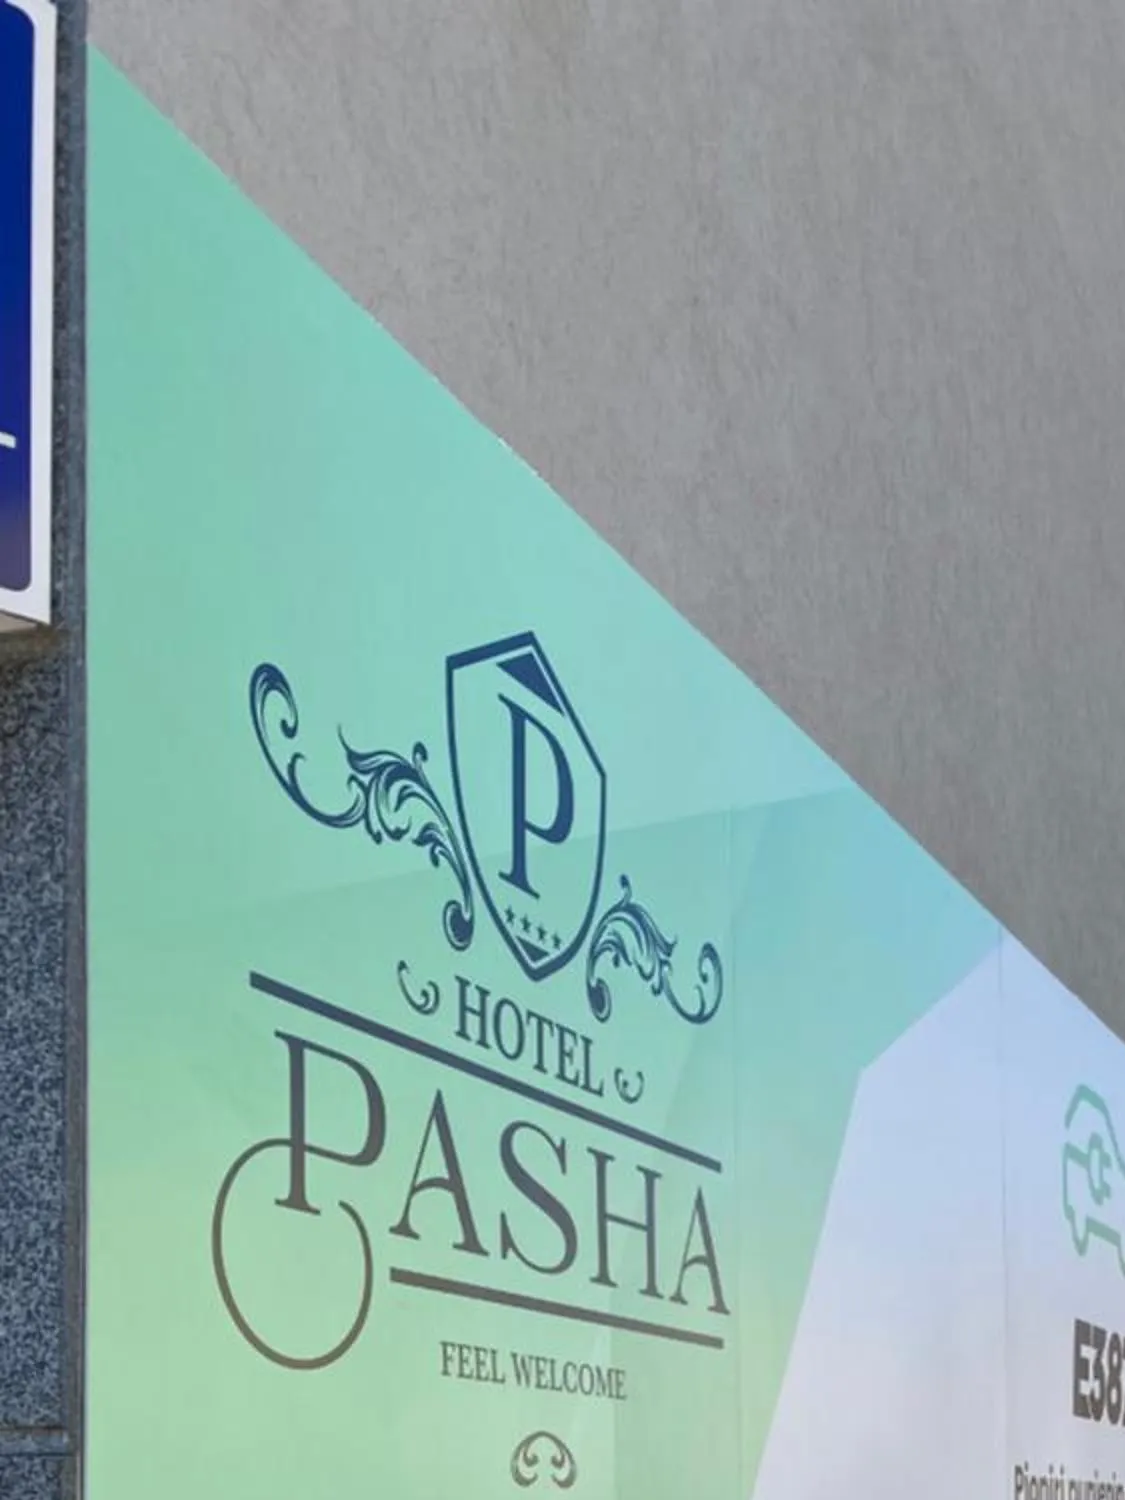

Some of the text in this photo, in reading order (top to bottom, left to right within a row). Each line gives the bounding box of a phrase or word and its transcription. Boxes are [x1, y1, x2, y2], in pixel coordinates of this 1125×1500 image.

[497, 692, 574, 899] P
[454, 974, 605, 1098] HOTEL
[211, 1029, 731, 1371] PASHA
[439, 1341, 628, 1402] FEEL WELCOME
